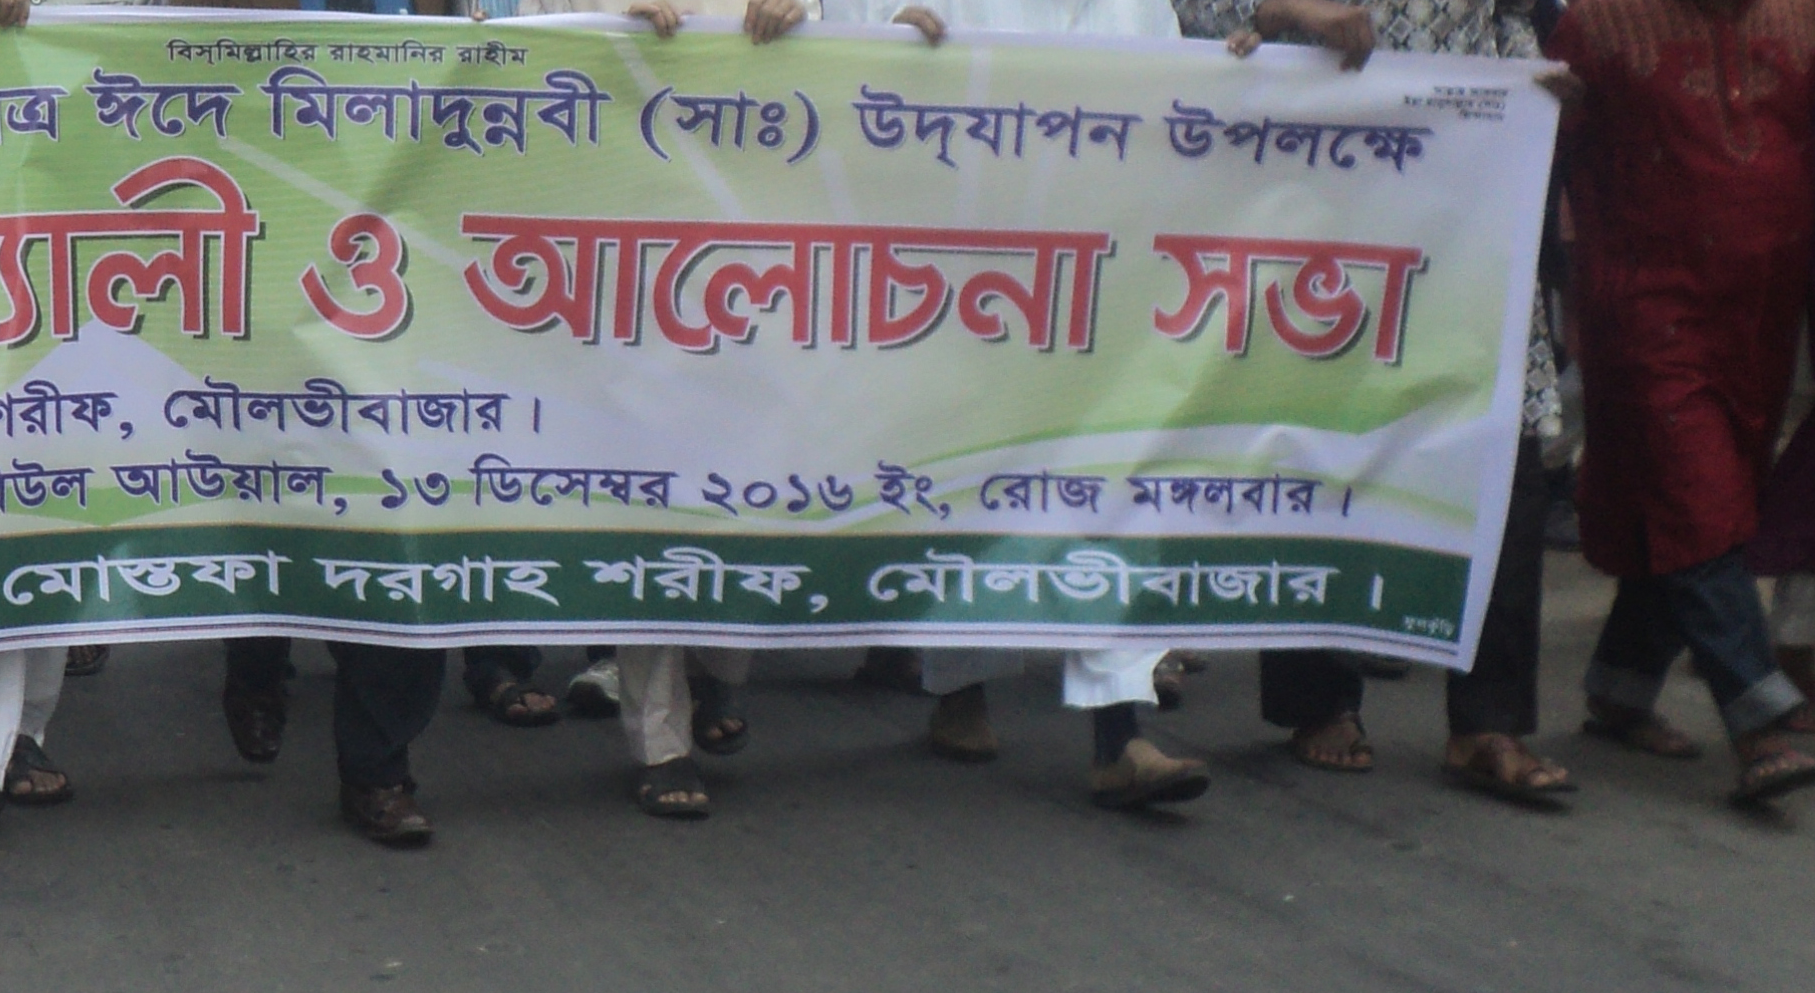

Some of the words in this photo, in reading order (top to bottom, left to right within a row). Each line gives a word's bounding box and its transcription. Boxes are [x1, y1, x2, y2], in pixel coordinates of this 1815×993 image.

[328, 40, 446, 66] রাহমানির
[456, 40, 529, 67] রাহীম
[85, 66, 244, 142] ঈদে
[258, 64, 612, 157] মিলাদুন্নবী
[638, 84, 821, 165] (সাঃ)
[1161, 98, 1434, 173] উপলক্ষে
[299, 210, 410, 343] ও
[459, 212, 1117, 357] আলোচনা
[1152, 232, 1431, 368] সভা
[164, 375, 512, 436] মৌলভীবাজার
[110, 450, 348, 515] আউয়াল,
[380, 467, 451, 510] ১৩
[469, 454, 679, 508] ডিসেম্বর
[701, 471, 854, 514] ২০১৬
[872, 460, 952, 520] ইং,
[979, 468, 1107, 515] রোজ
[1125, 472, 1324, 517] মঙ্গলবার
[2, 549, 292, 608] মোস্তফা
[313, 552, 561, 607] দরগাহ
[584, 546, 829, 613] শরীফ,
[868, 545, 1340, 607] মৌলভীবাজার
